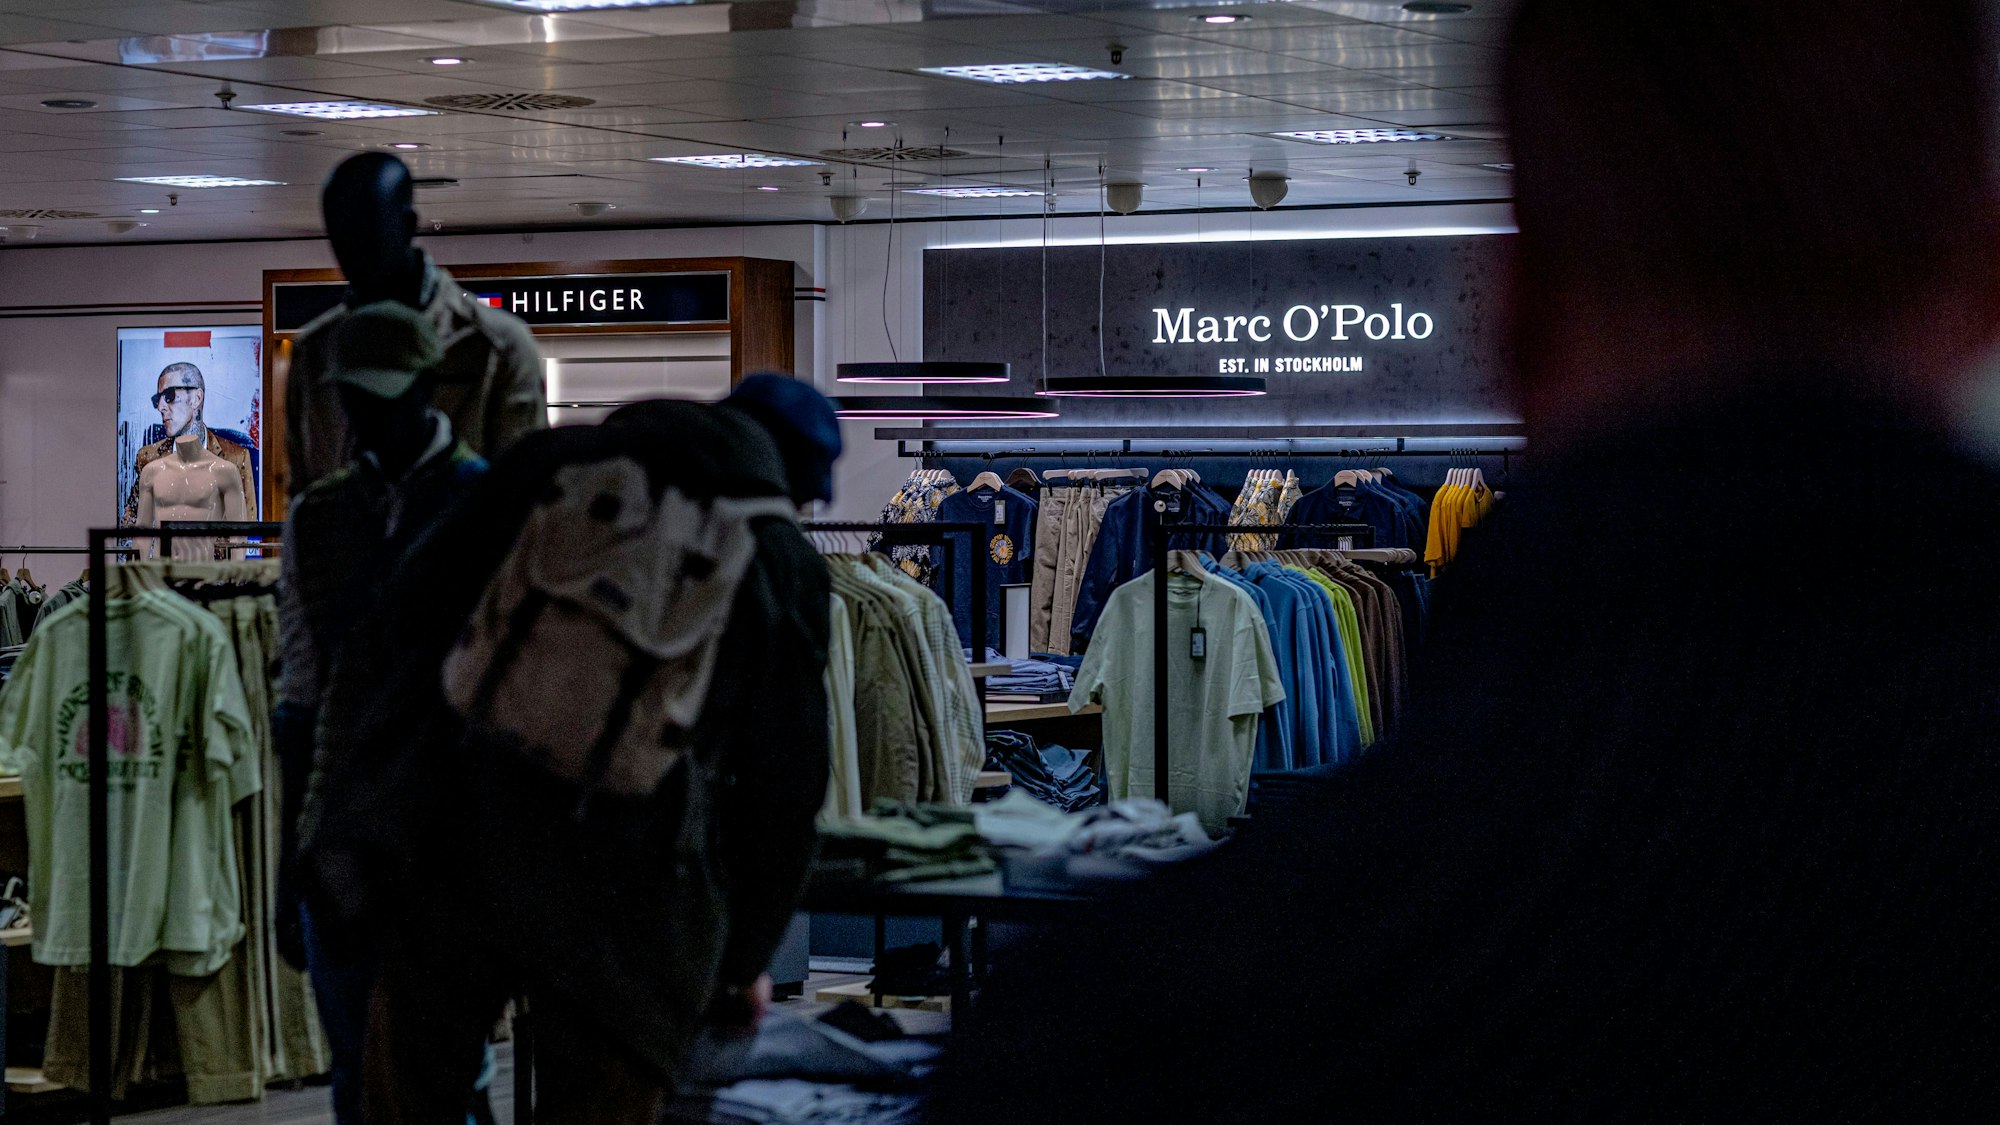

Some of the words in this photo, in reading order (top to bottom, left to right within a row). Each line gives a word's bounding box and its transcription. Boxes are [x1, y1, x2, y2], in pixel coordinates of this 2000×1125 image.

[511, 288, 646, 313] HILFIGER
[1151, 307, 1272, 344] Marc
[1282, 302, 1434, 342] O'Polo
[1218, 357, 1250, 374] EST.
[1254, 357, 1270, 373] IN
[1274, 356, 1363, 373] STOCKHOLM
